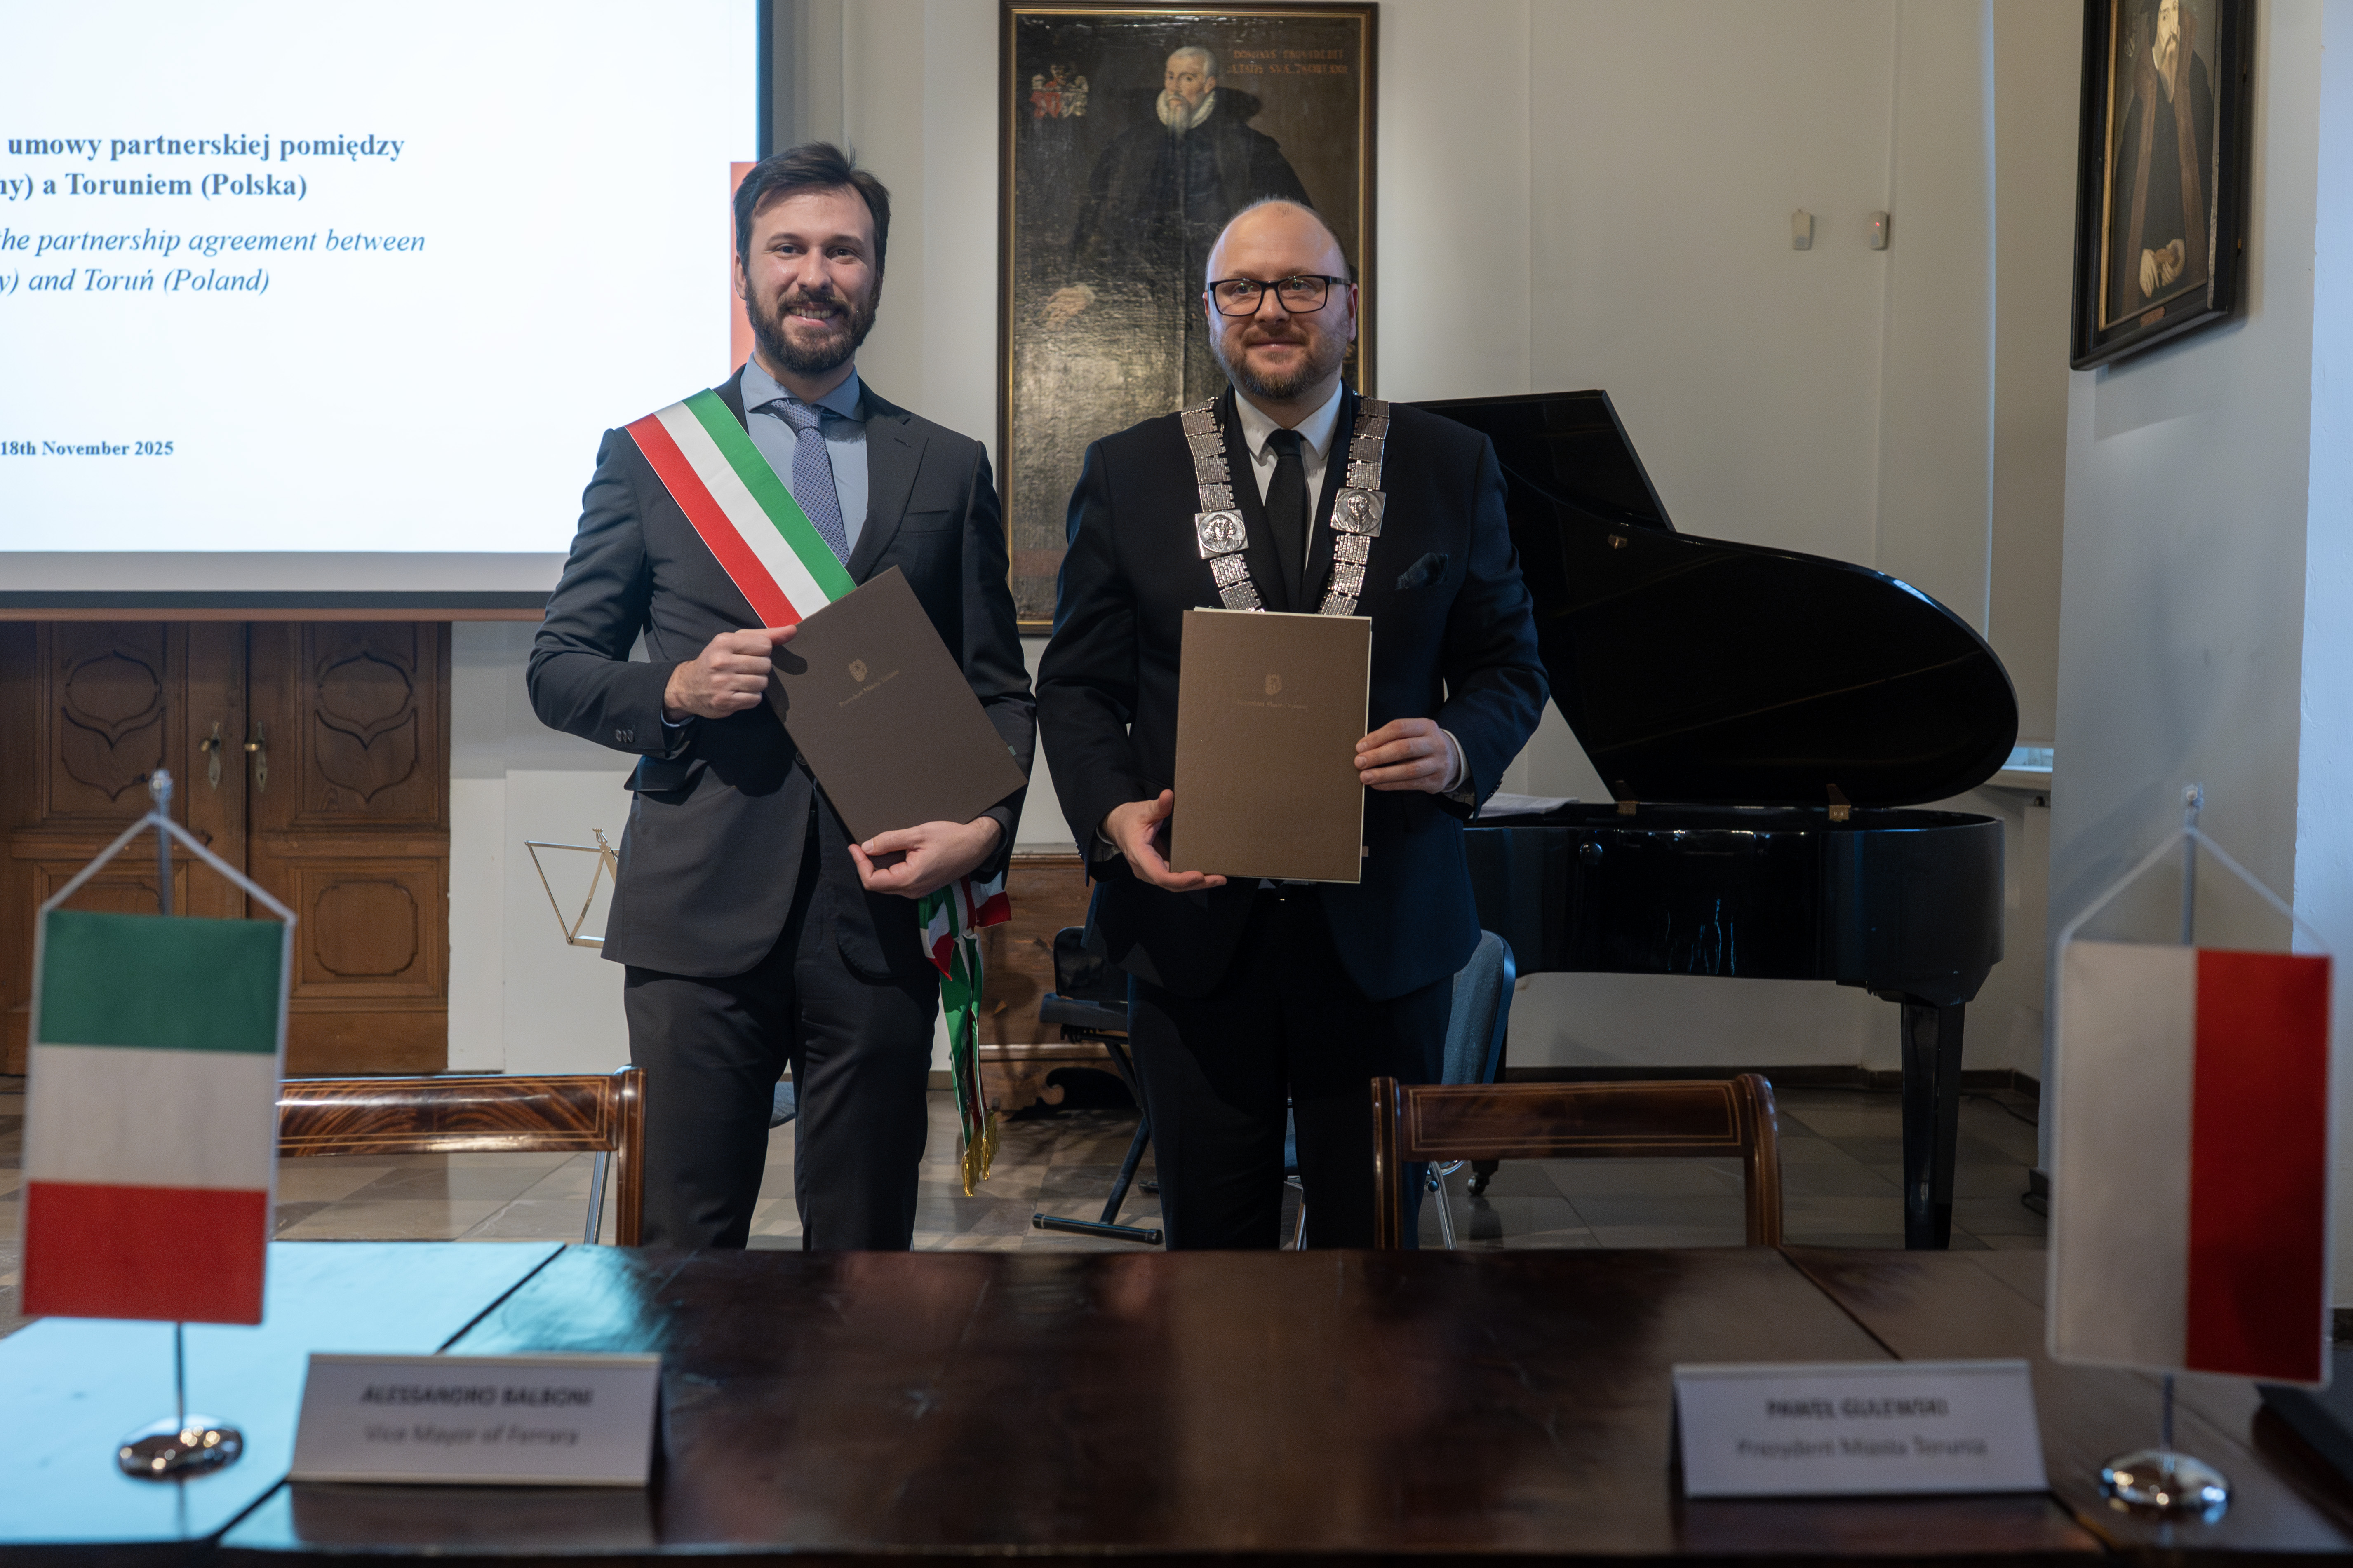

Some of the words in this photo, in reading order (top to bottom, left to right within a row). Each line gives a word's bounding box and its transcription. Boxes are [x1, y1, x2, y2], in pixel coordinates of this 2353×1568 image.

[8, 139, 102, 162] umowy
[110, 133, 270, 162] partnerskiej
[280, 134, 404, 162] pomiędzy
[43, 179, 56, 195] a
[65, 173, 192, 195] Toruniem
[201, 173, 307, 201] (Polska)
[34, 228, 181, 257] partnership
[188, 232, 317, 257] agreement
[325, 228, 425, 251] between
[28, 268, 77, 291] and
[85, 268, 154, 291] Toruń
[164, 268, 269, 295] (Poland)
[1, 441, 37, 456] 18th
[42, 441, 130, 456] November
[134, 441, 174, 455] 2025
